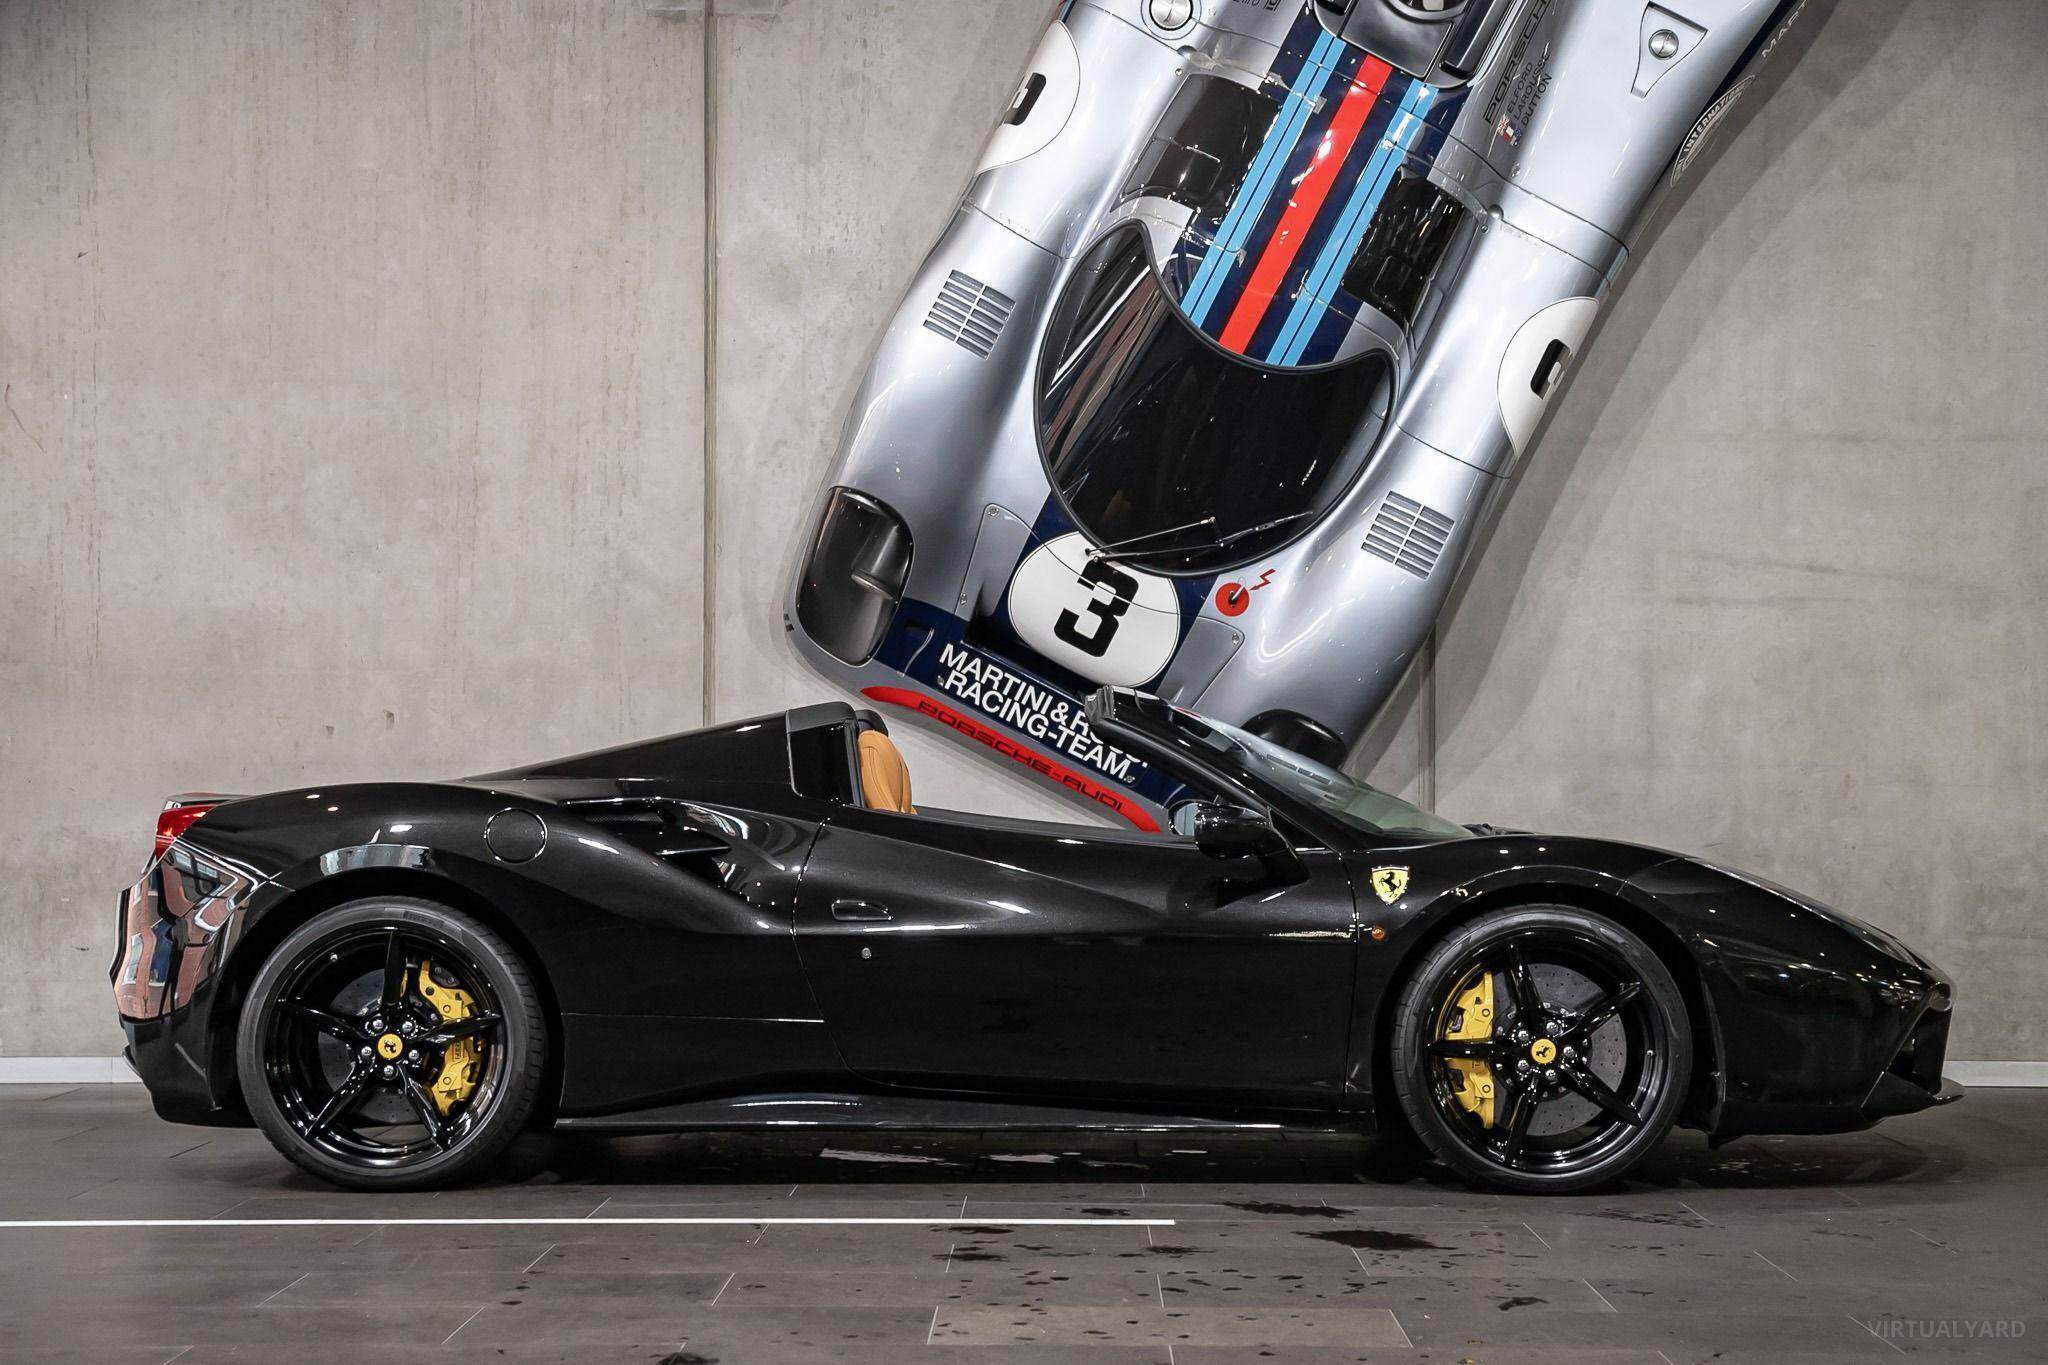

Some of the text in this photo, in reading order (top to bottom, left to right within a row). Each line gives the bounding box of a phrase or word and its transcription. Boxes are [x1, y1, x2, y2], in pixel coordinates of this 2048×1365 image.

[1507, 62, 1534, 113] ELFORD
[1521, 73, 1553, 127] DUTTON
[1054, 560, 1139, 657] 3
[939, 643, 1054, 715] MARTINI
[918, 700, 1122, 812] PORSCHE-AUDI
